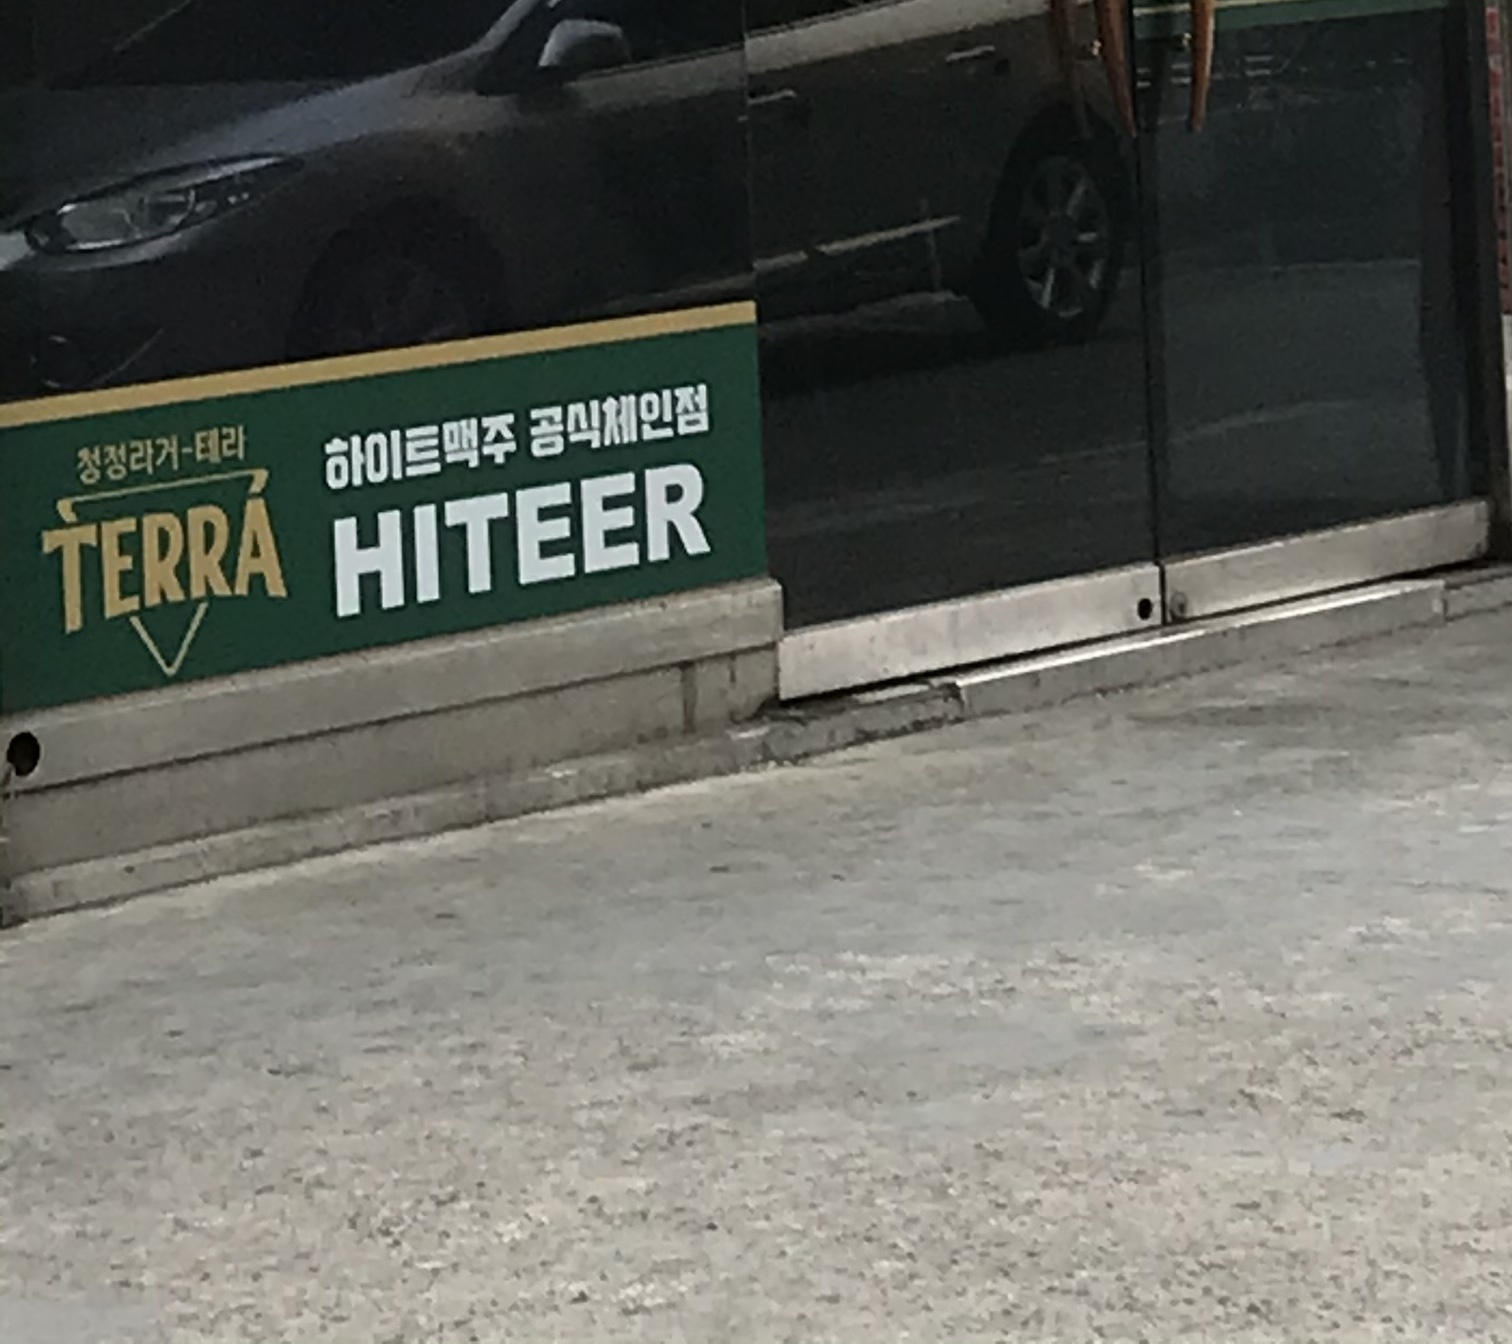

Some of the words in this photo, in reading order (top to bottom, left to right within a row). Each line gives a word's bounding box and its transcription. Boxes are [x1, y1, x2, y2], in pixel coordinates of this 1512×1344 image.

[76, 425, 247, 485] 청정라거-테라
[325, 412, 517, 490] 하이트맥주
[529, 384, 711, 458] 공식체인점
[42, 496, 287, 634] TERRA
[333, 462, 712, 618] HITEER
